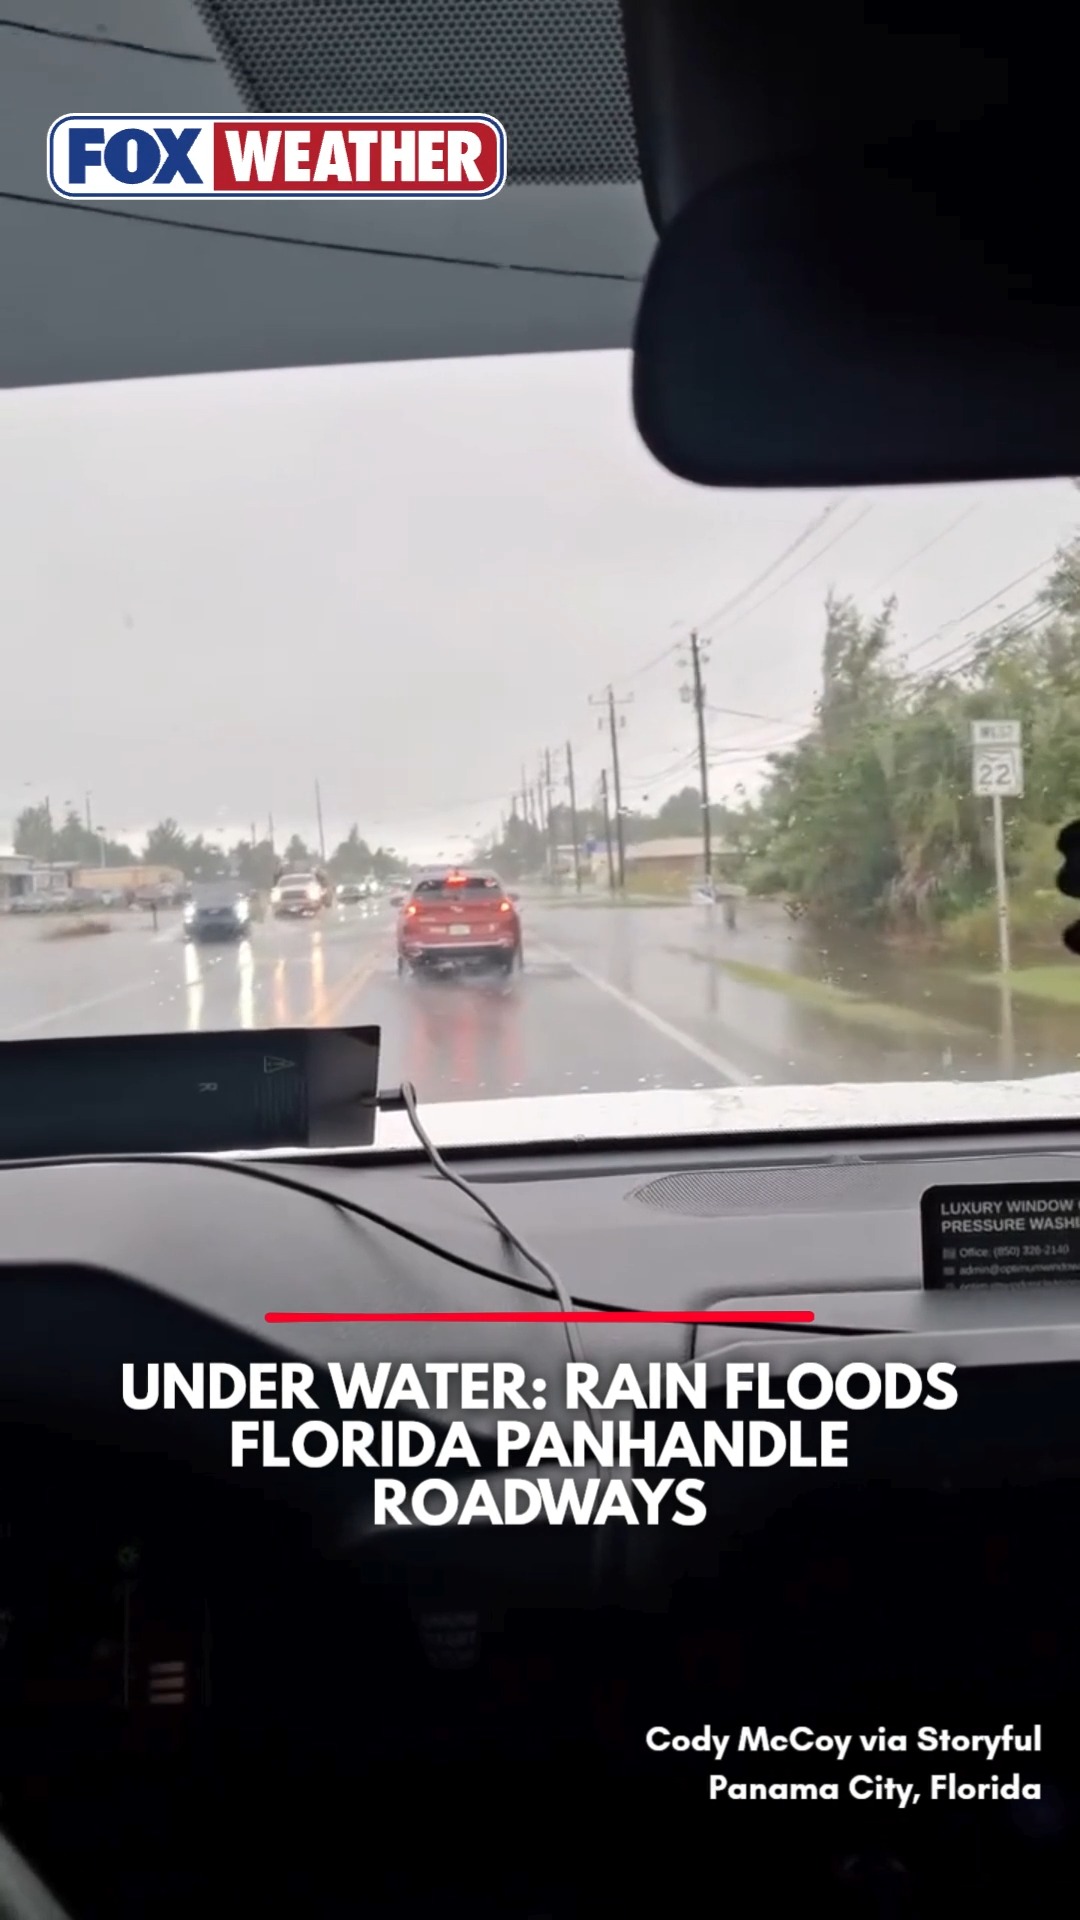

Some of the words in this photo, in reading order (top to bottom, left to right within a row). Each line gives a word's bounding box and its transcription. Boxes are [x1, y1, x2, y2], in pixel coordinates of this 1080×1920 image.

[979, 763, 1011, 785] 22
[940, 1200, 1003, 1216] LUXURY
[1006, 1199, 1074, 1213] WINDOW
[941, 1217, 1026, 1233] PRESSURE
[993, 1245, 1020, 1259] (850)
